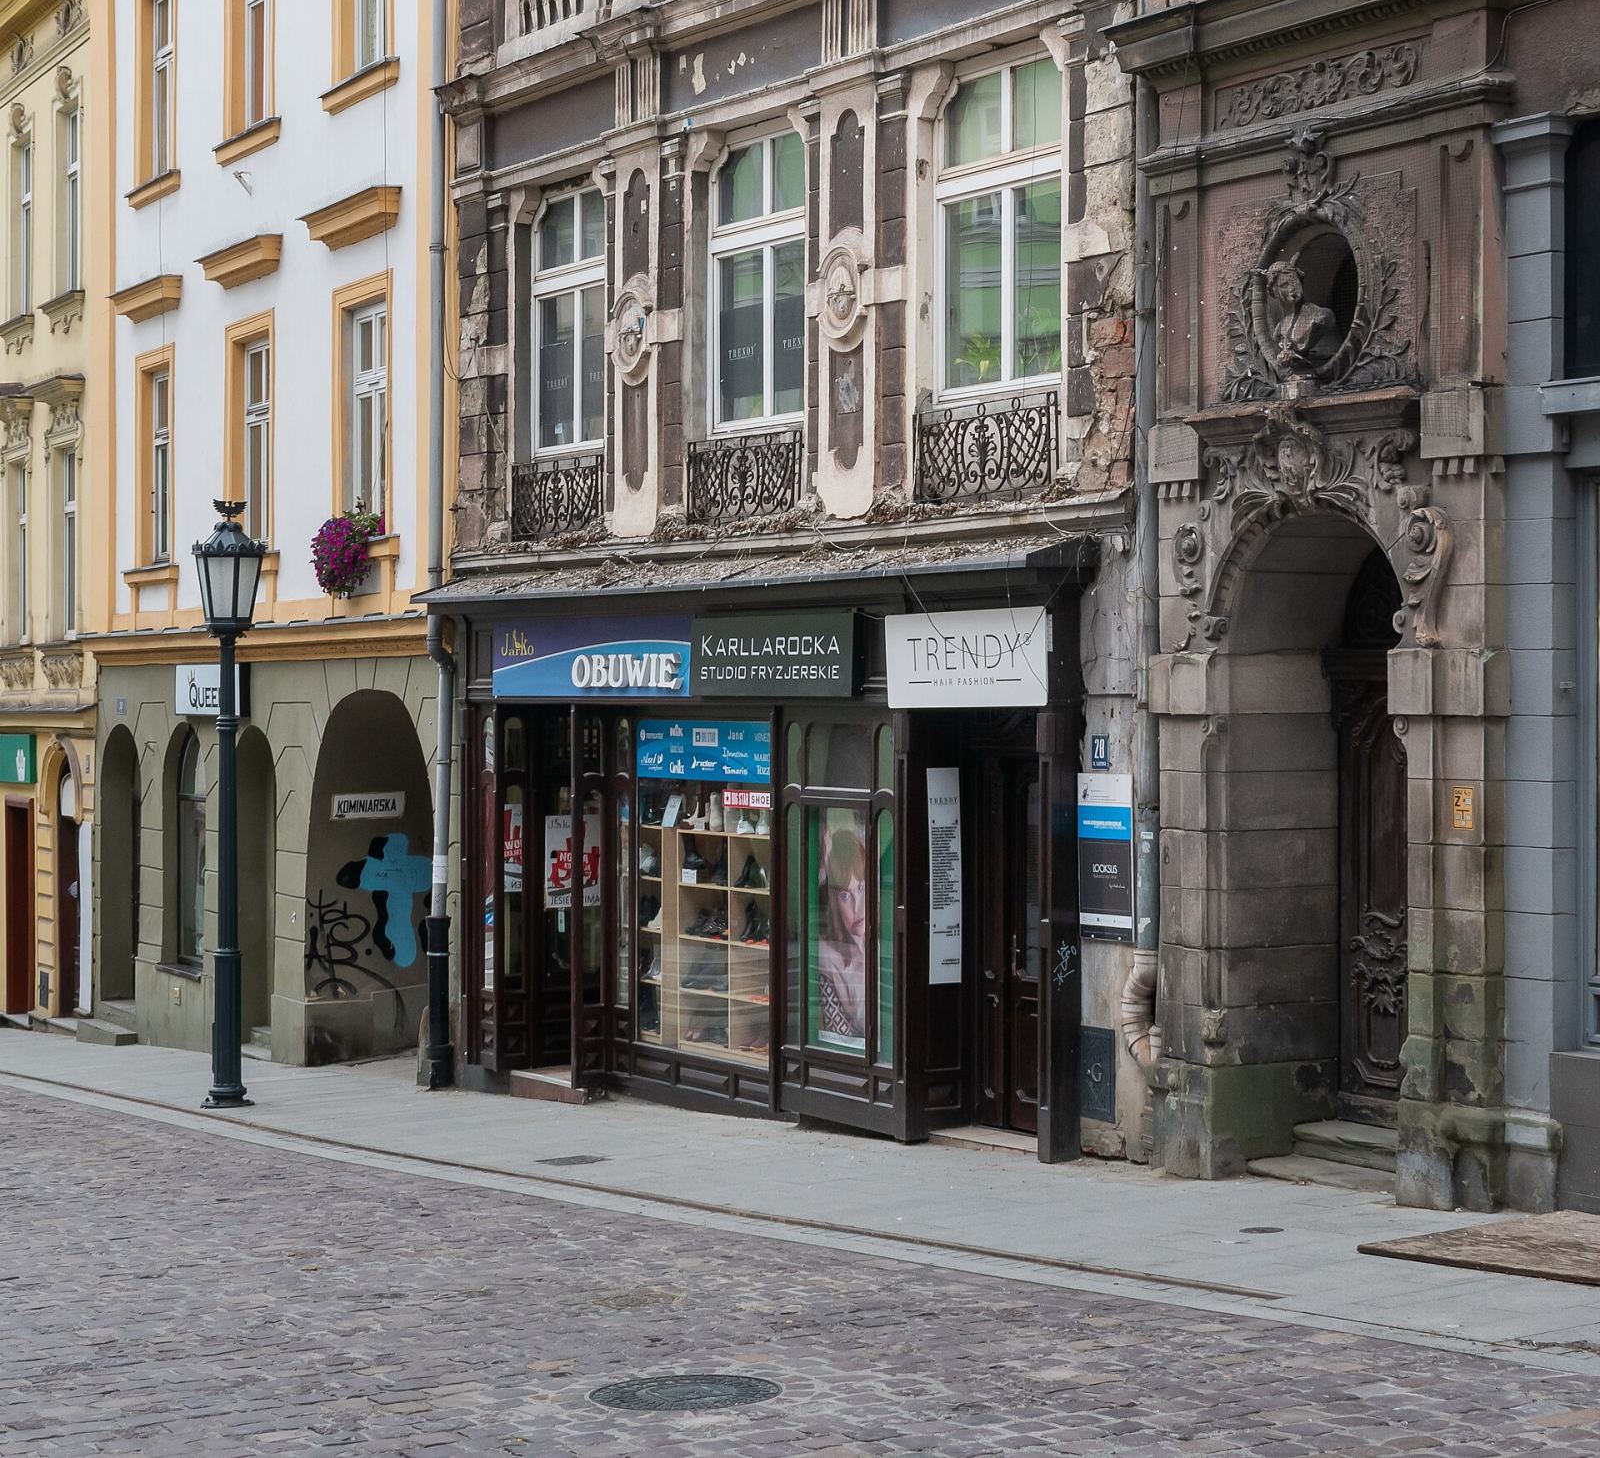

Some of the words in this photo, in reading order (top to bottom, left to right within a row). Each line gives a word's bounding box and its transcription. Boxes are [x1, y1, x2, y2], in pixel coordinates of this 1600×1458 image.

[571, 652, 684, 690] OBUWIE
[700, 666, 746, 680] STUDIO
[750, 665, 840, 680] FRYZJERSKIE
[933, 679, 953, 687] HAIR
[957, 677, 995, 686] FASHION
[727, 729, 743, 741] Jana
[337, 798, 397, 813] KOMINIARSKA
[550, 897, 571, 905] JESIE
